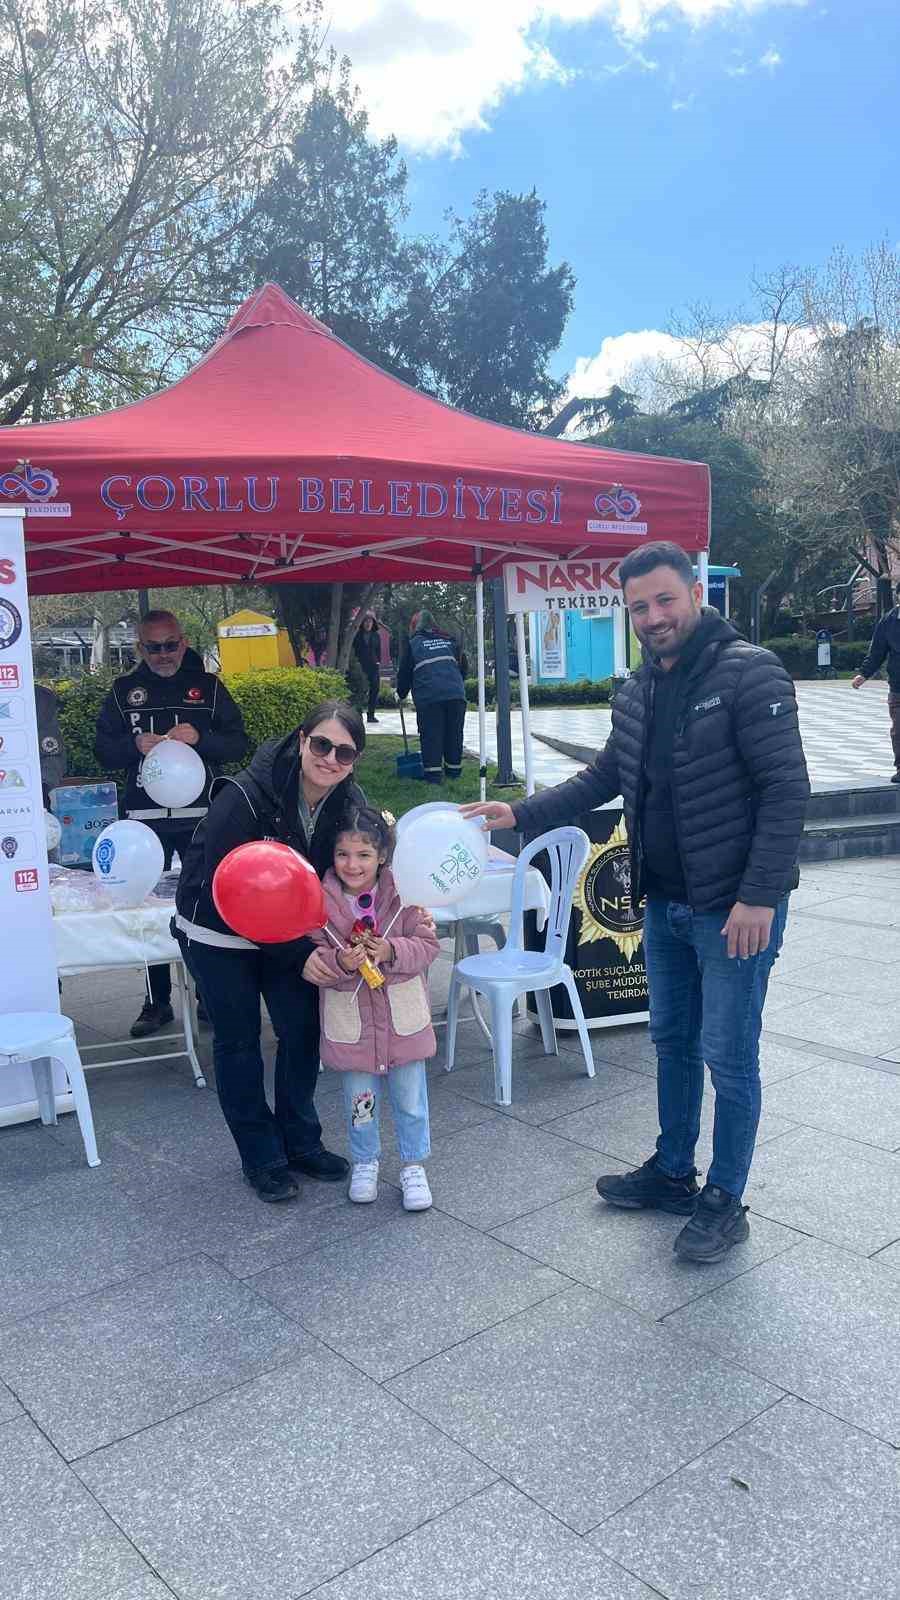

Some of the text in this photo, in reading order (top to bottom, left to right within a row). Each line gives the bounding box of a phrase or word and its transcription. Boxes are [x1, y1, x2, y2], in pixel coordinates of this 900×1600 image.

[100, 474, 562, 524] ÇORLU BELEDİYESİ
[516, 561, 621, 593] NARK
[17, 871, 36, 883] 112
[603, 963, 647, 977] SUÇLARL
[585, 975, 649, 992] ŞUBE MÜDÜR
